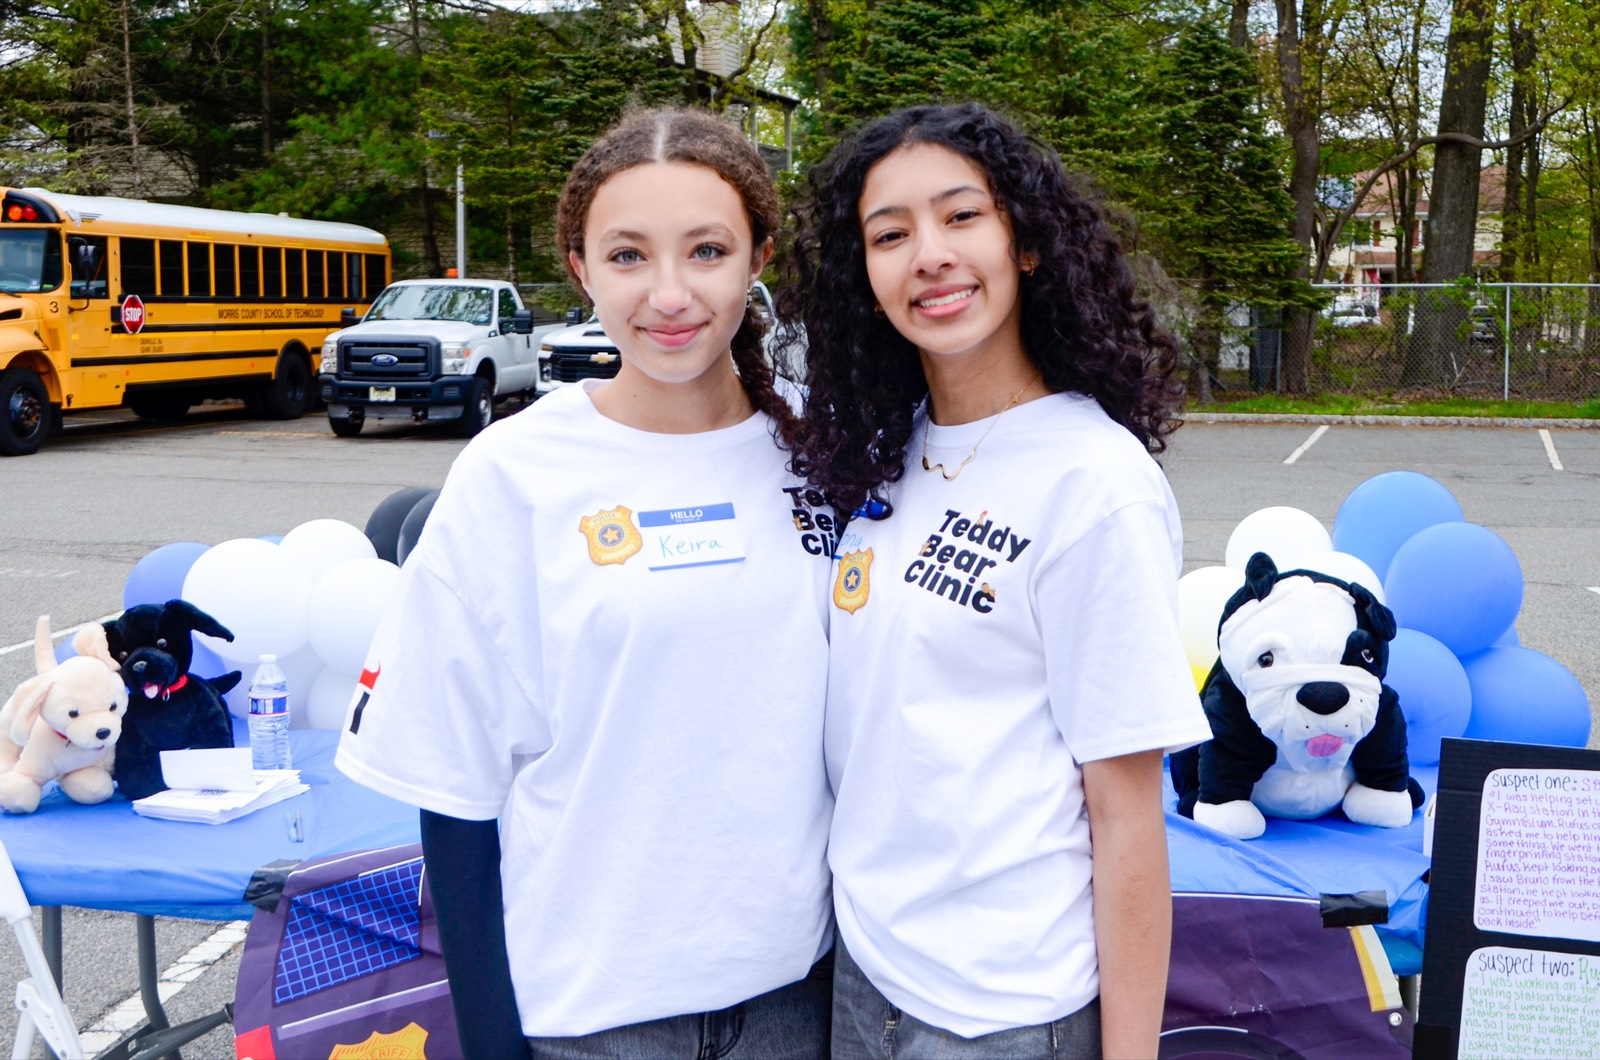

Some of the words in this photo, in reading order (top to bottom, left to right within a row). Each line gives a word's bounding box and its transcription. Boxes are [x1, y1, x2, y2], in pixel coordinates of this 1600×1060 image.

[50, 301, 59, 313] 3
[218, 308, 239, 319] MORRIS
[241, 308, 262, 319] COUNTY
[264, 308, 284, 319] SCHOOL
[286, 308, 293, 318] OF
[294, 308, 325, 318] TECHNOLOGY
[125, 307, 142, 322] STOP
[593, 513, 615, 523] POLICE
[670, 509, 703, 520] HELLO
[939, 509, 1031, 562] Teddy
[659, 535, 722, 558] Keira
[919, 534, 997, 577] Bear
[904, 559, 995, 613] Clinic
[1545, 776, 1577, 791] one:
[1506, 793, 1528, 801] was
[1530, 792, 1572, 809] helping
[1575, 795, 1592, 805] set
[1487, 801, 1528, 818] X-Ray
[1530, 804, 1574, 816] station
[1558, 818, 1590, 830] Rufus
[1525, 831, 1540, 839] me
[1543, 830, 1553, 840] to
[1556, 830, 1580, 843] help
[1568, 842, 1593, 852] went
[1486, 848, 1562, 863] fingerprinting
[1485, 859, 1521, 872] Rufus
[1523, 861, 1549, 874] kept
[1552, 862, 1588, 876] looking
[1489, 875, 1513, 884] saw
[1516, 874, 1549, 885] Bruno
[1552, 874, 1576, 884] from
[1579, 875, 1595, 886] the
[1541, 887, 1567, 900] kept
[1549, 900, 1564, 908] me
[1477, 906, 1539, 918] continued
[1554, 908, 1578, 922] help
[1477, 916, 1502, 926] back
[1541, 953, 1574, 977] two:
[1515, 977, 1559, 994] working
[1514, 990, 1554, 1002] station
[364, 1047, 406, 1060] ERIFF
